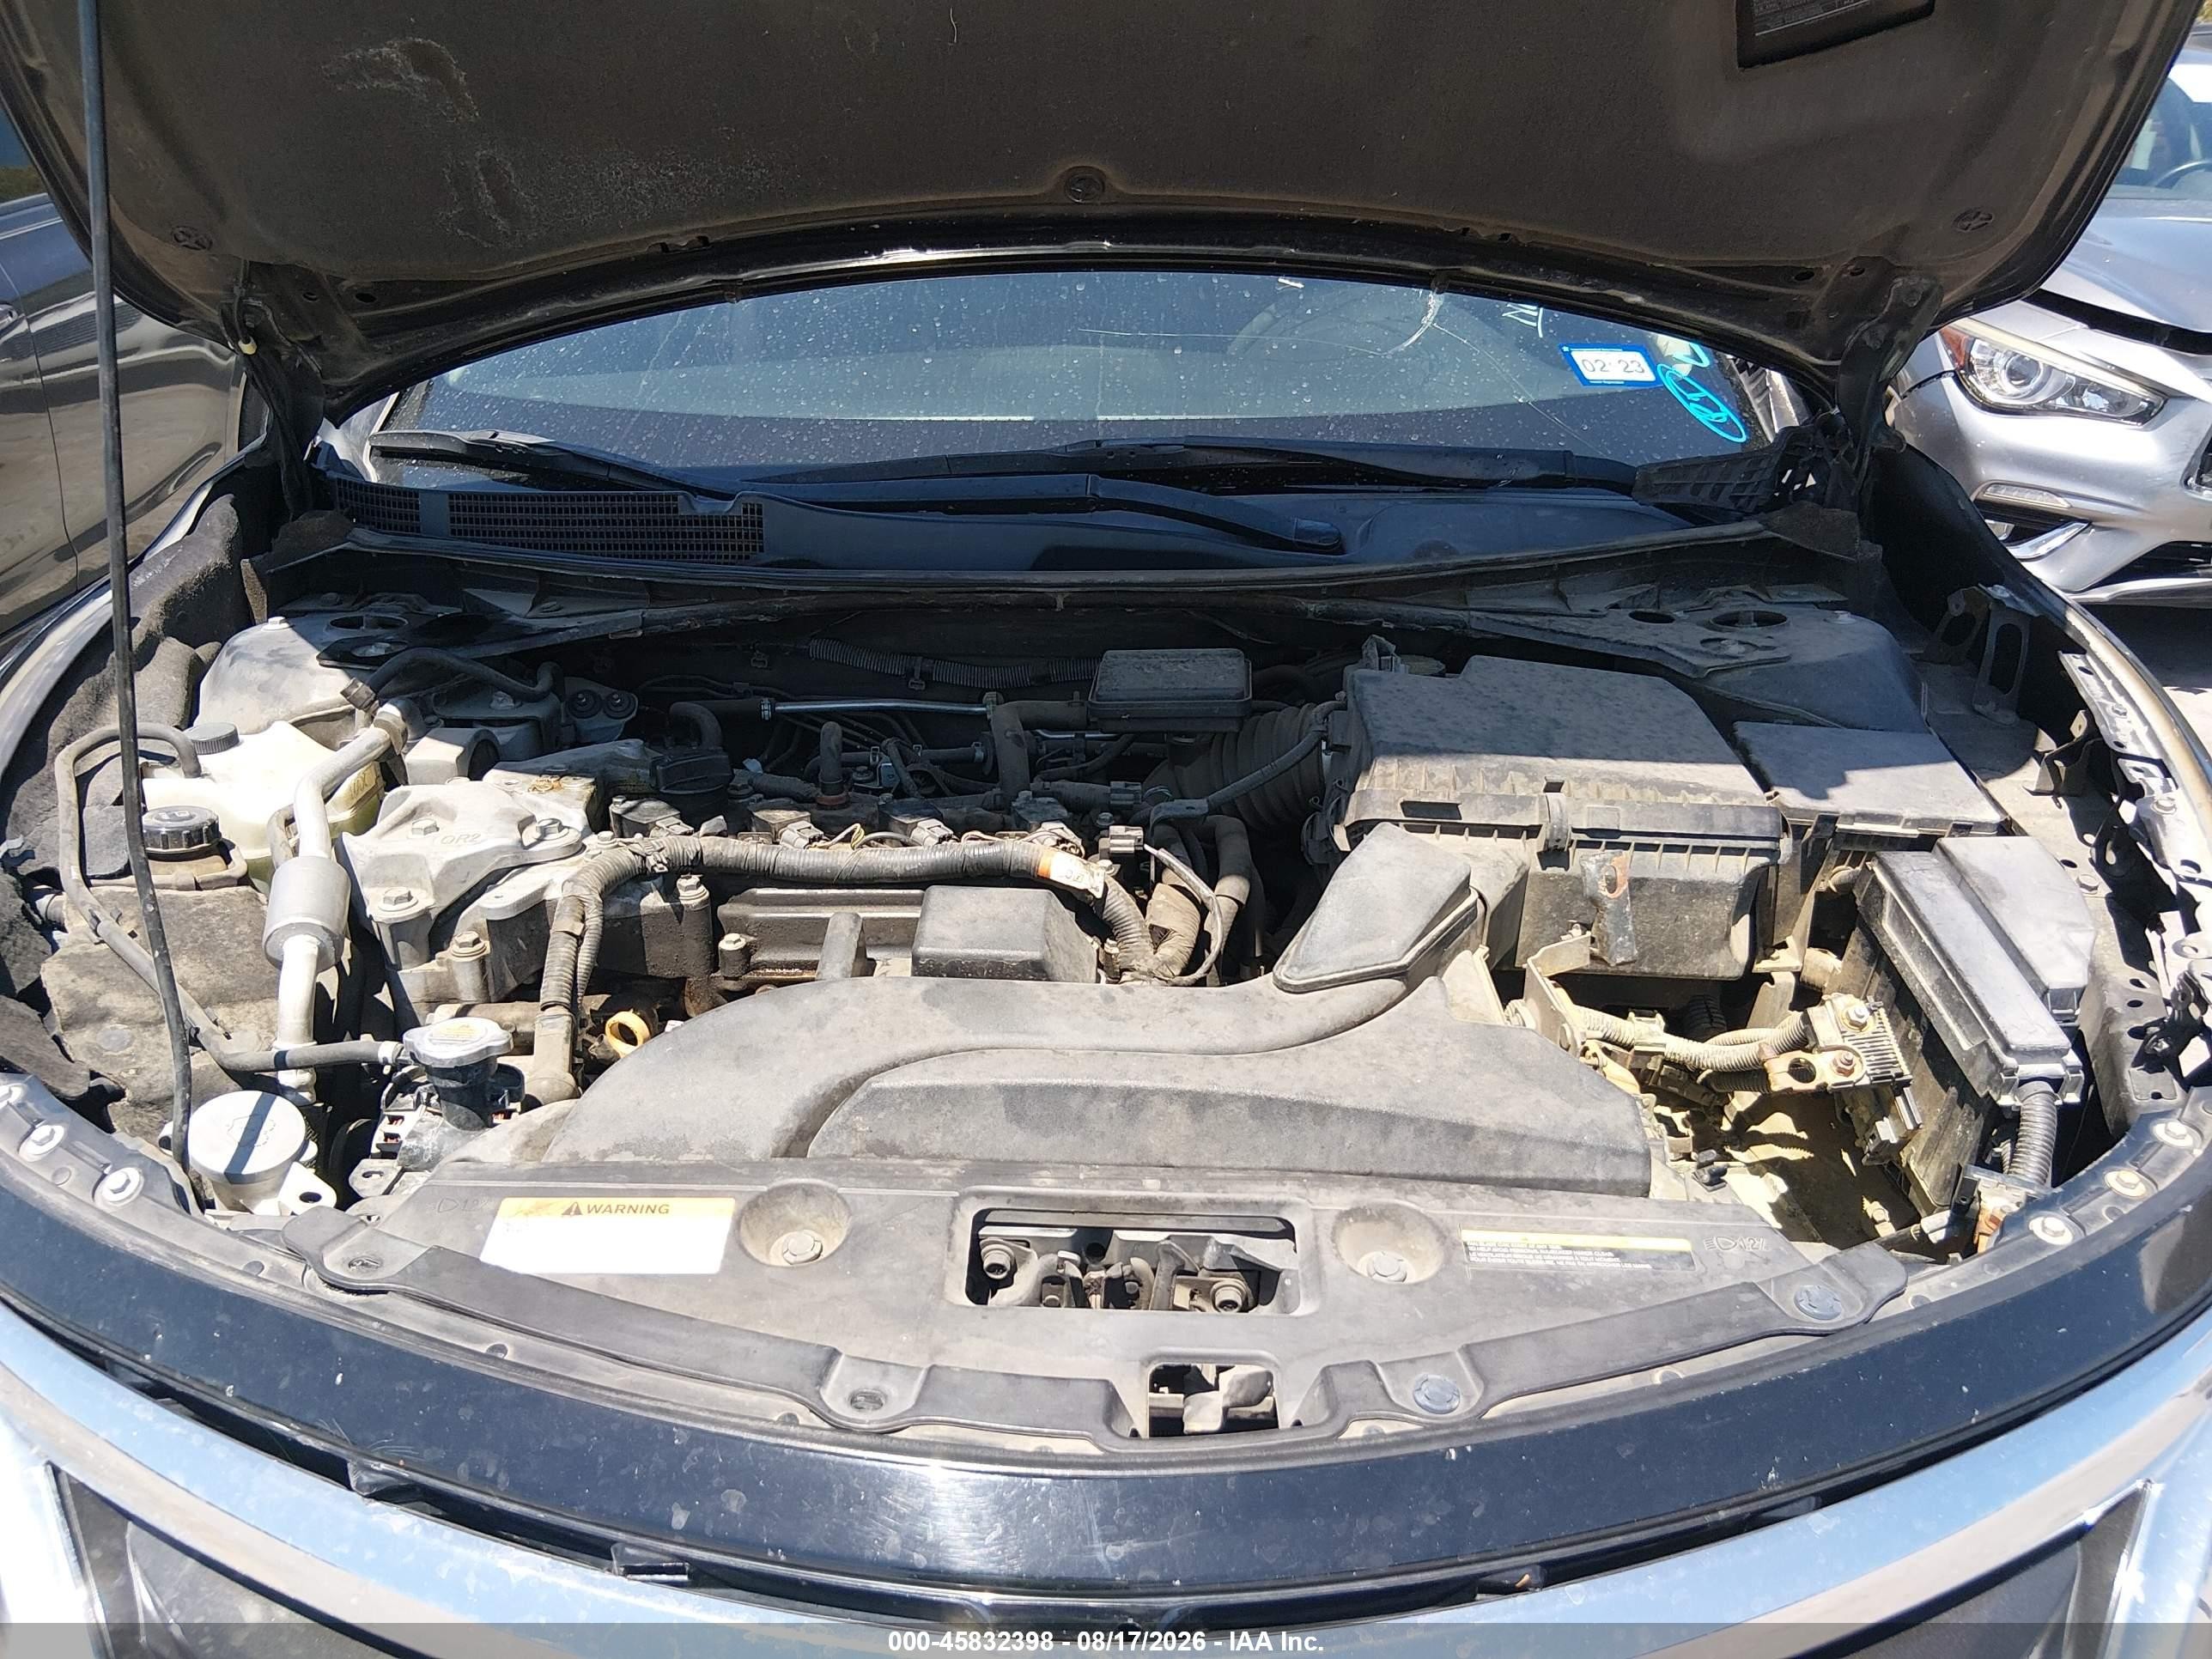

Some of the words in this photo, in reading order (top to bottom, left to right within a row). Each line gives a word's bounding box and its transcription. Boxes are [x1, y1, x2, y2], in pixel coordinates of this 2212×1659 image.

[1581, 358, 1610, 373] 02
[1617, 358, 1645, 374] 23
[586, 1203, 671, 1215] WARNING
